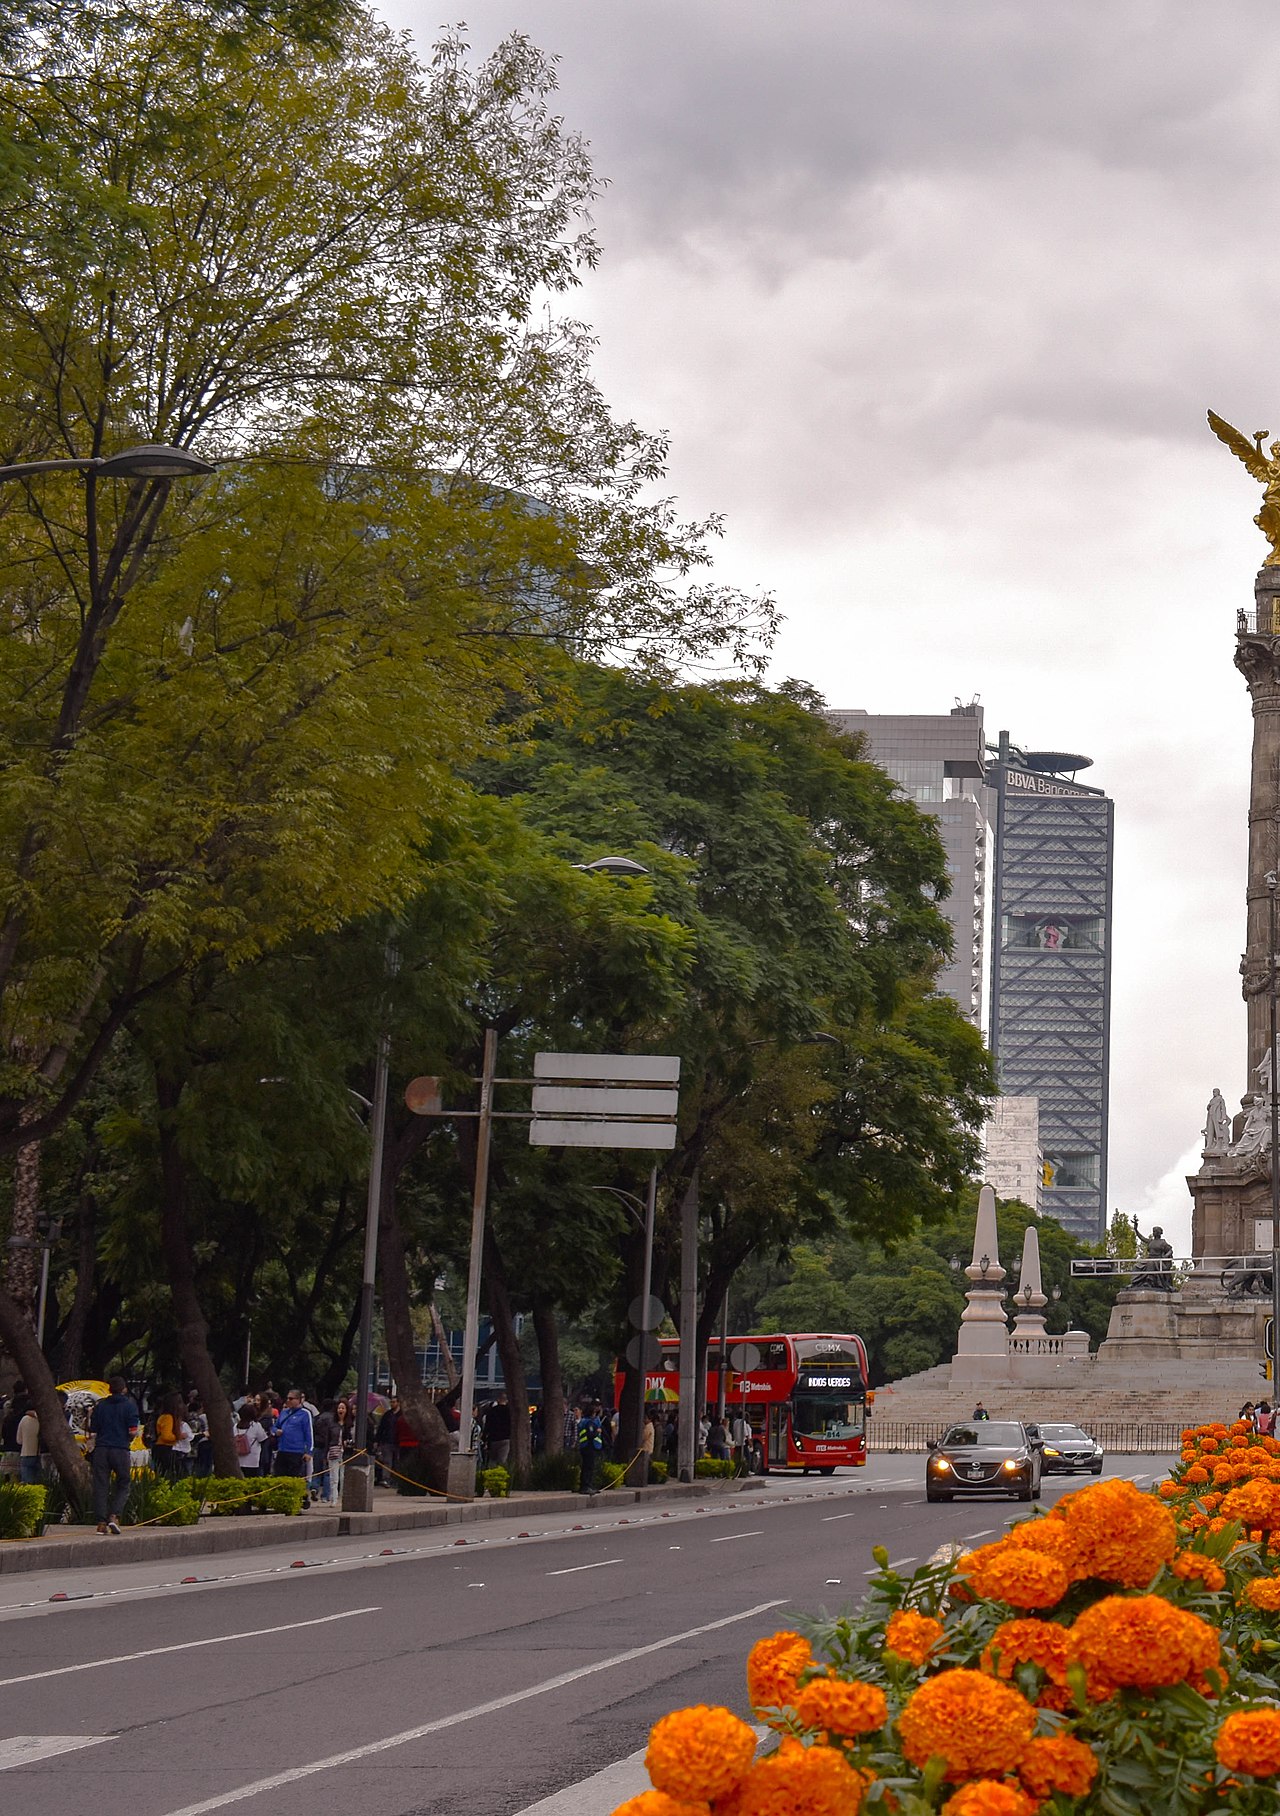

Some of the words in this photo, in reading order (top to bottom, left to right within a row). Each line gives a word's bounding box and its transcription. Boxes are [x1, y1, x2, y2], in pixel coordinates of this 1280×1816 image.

[1007, 770, 1036, 791] BBVA
[1037, 778, 1089, 795] Bancom
[770, 1344, 784, 1352] CDMX
[645, 1377, 666, 1389] DMX
